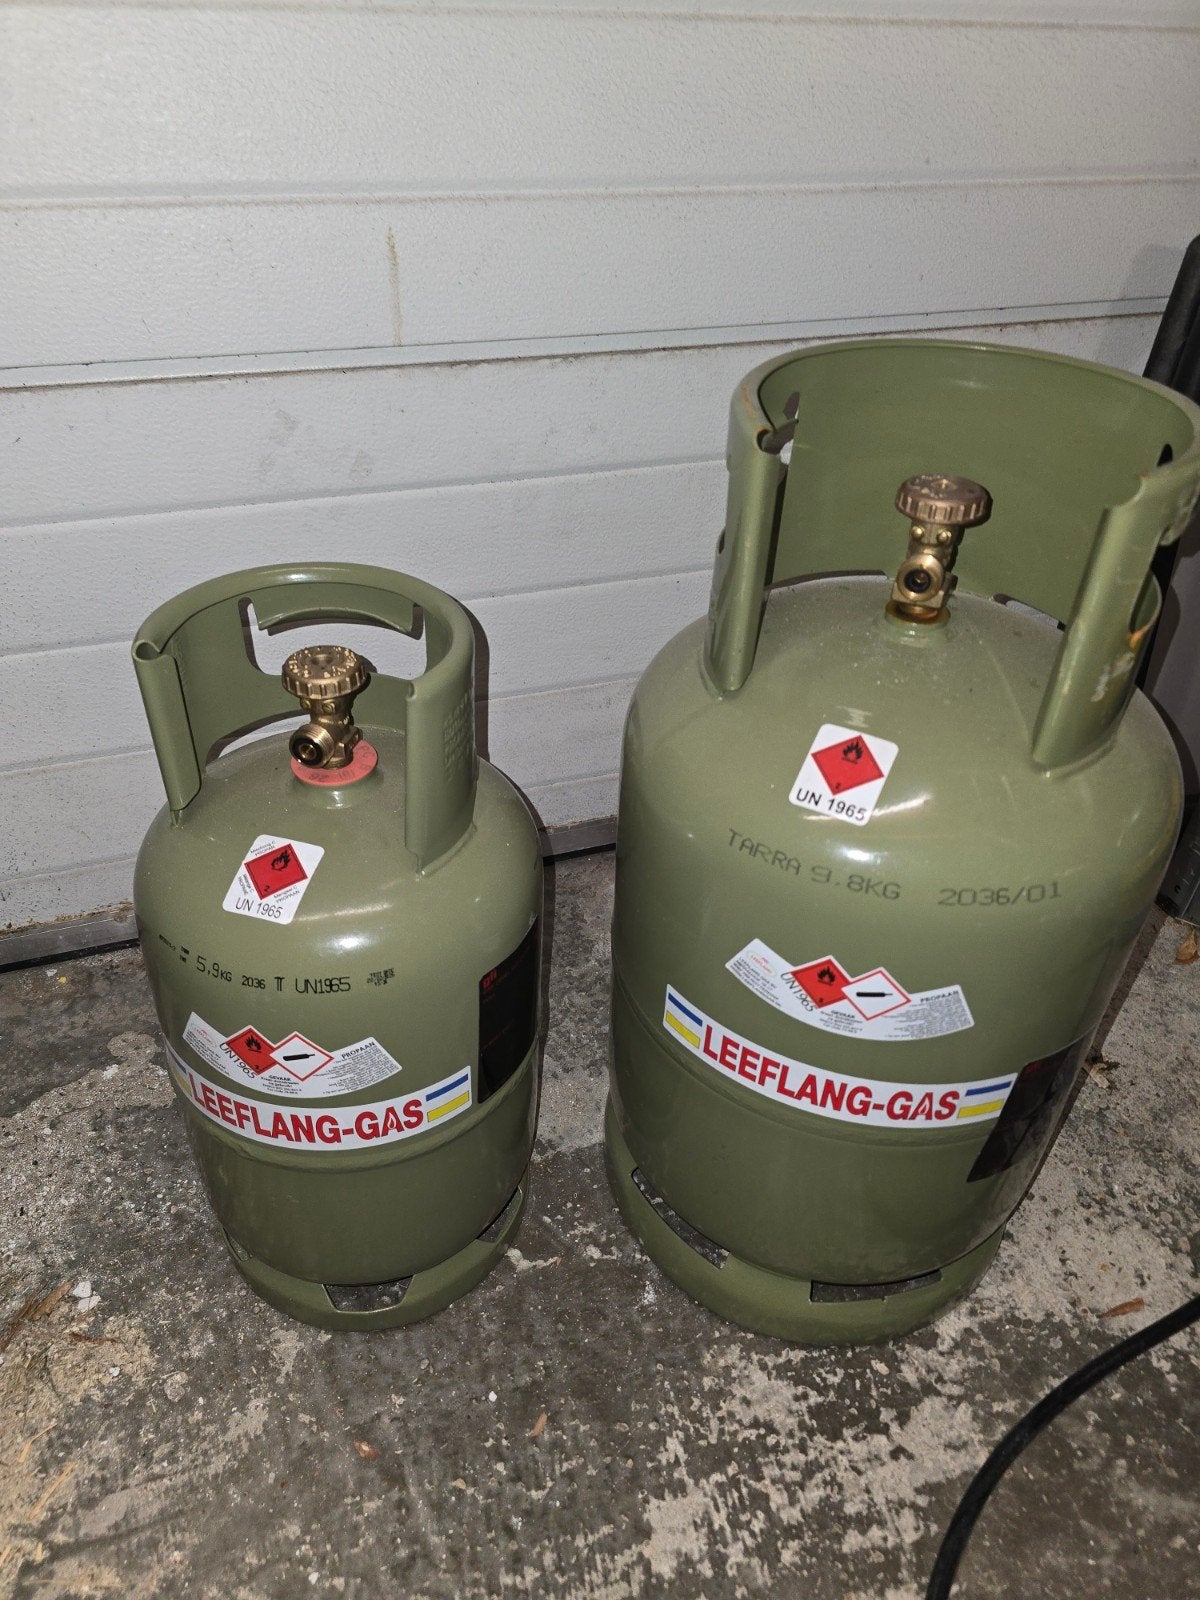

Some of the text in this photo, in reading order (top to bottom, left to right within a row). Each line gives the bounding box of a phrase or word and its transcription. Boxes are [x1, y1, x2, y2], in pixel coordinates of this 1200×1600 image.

[796, 788, 867, 821] UN 1965
[728, 828, 1063, 907] TARRA 9.8KG 2036/01
[235, 897, 283, 919] UN 1965
[241, 974, 266, 990] 2036
[295, 976, 351, 994] UN1965
[780, 972, 817, 1012] UN1965
[218, 1042, 258, 1080] UN1965
[341, 1041, 376, 1060] PROPAAN
[703, 1025, 960, 1121] LEEFLANG-GAS
[188, 1072, 424, 1144] LEEFLANG-GAS
